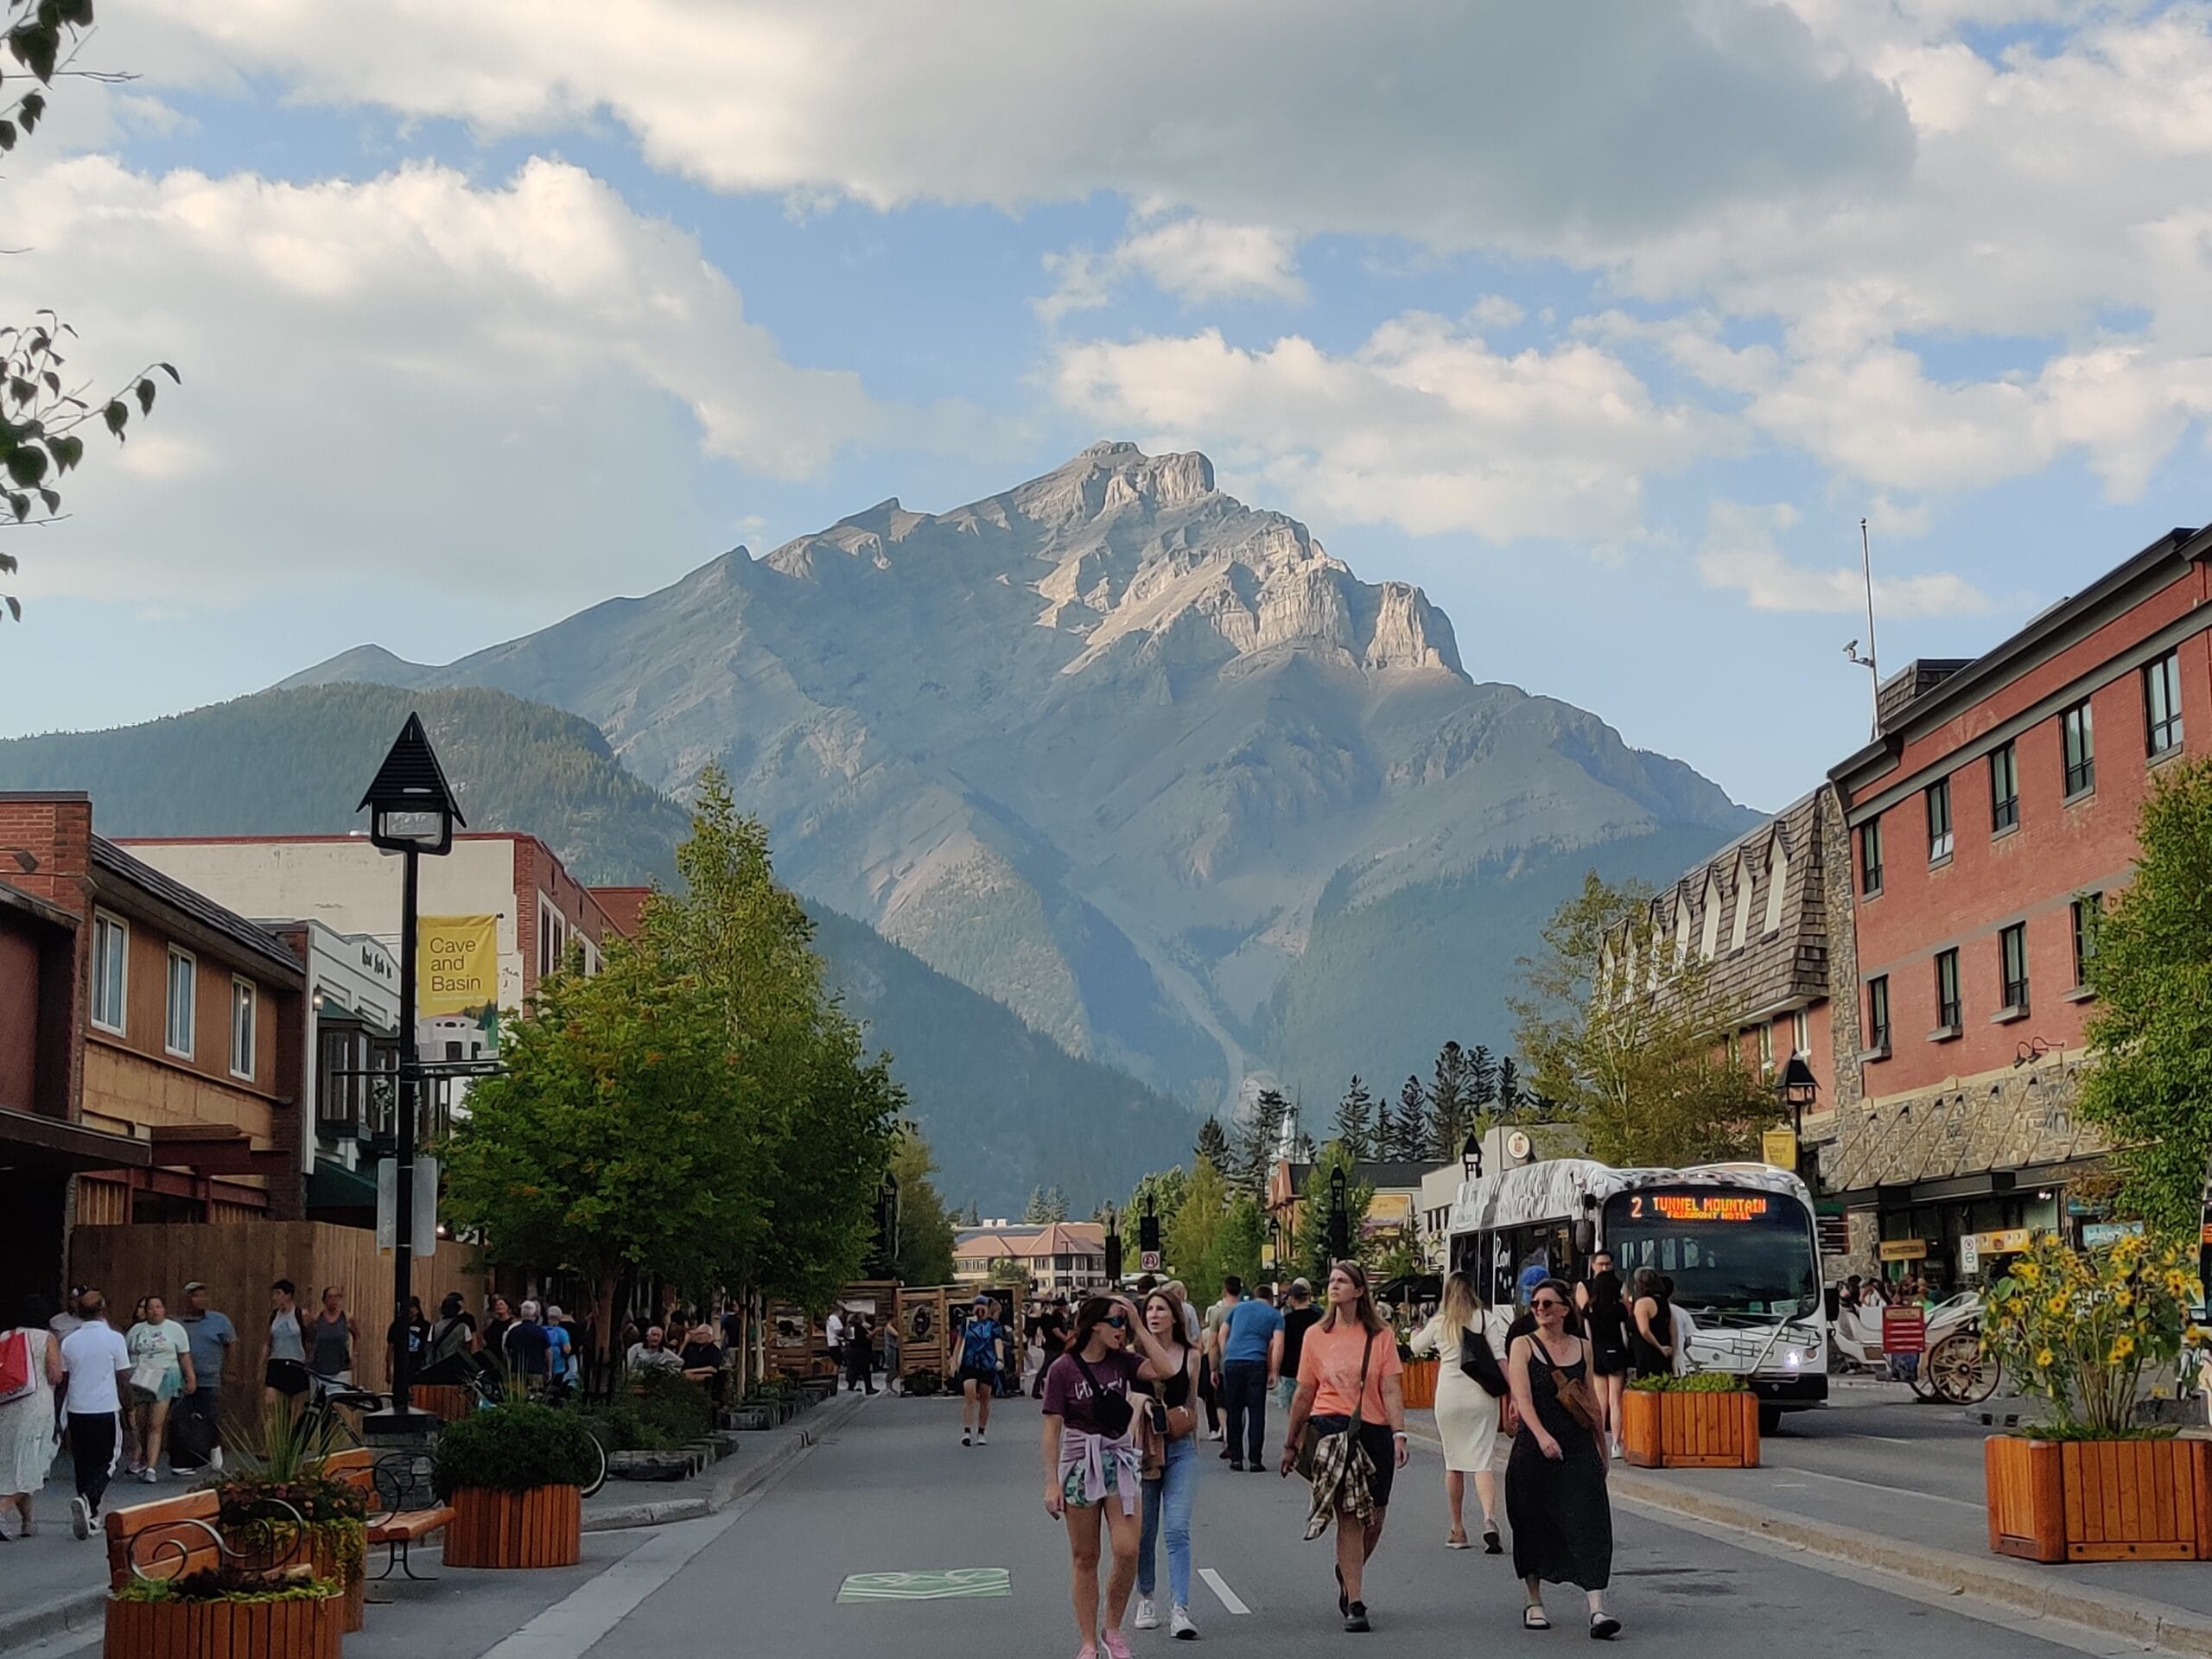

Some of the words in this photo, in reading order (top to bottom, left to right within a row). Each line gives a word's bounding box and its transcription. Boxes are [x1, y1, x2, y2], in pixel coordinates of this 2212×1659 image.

[429, 937, 476, 954] Cave
[430, 955, 465, 971] and
[431, 975, 481, 991] Basin
[1630, 1197, 1642, 1217] 2
[1652, 1197, 1700, 1211] TUNNEL
[1703, 1198, 1767, 1212] MOUNTAIN
